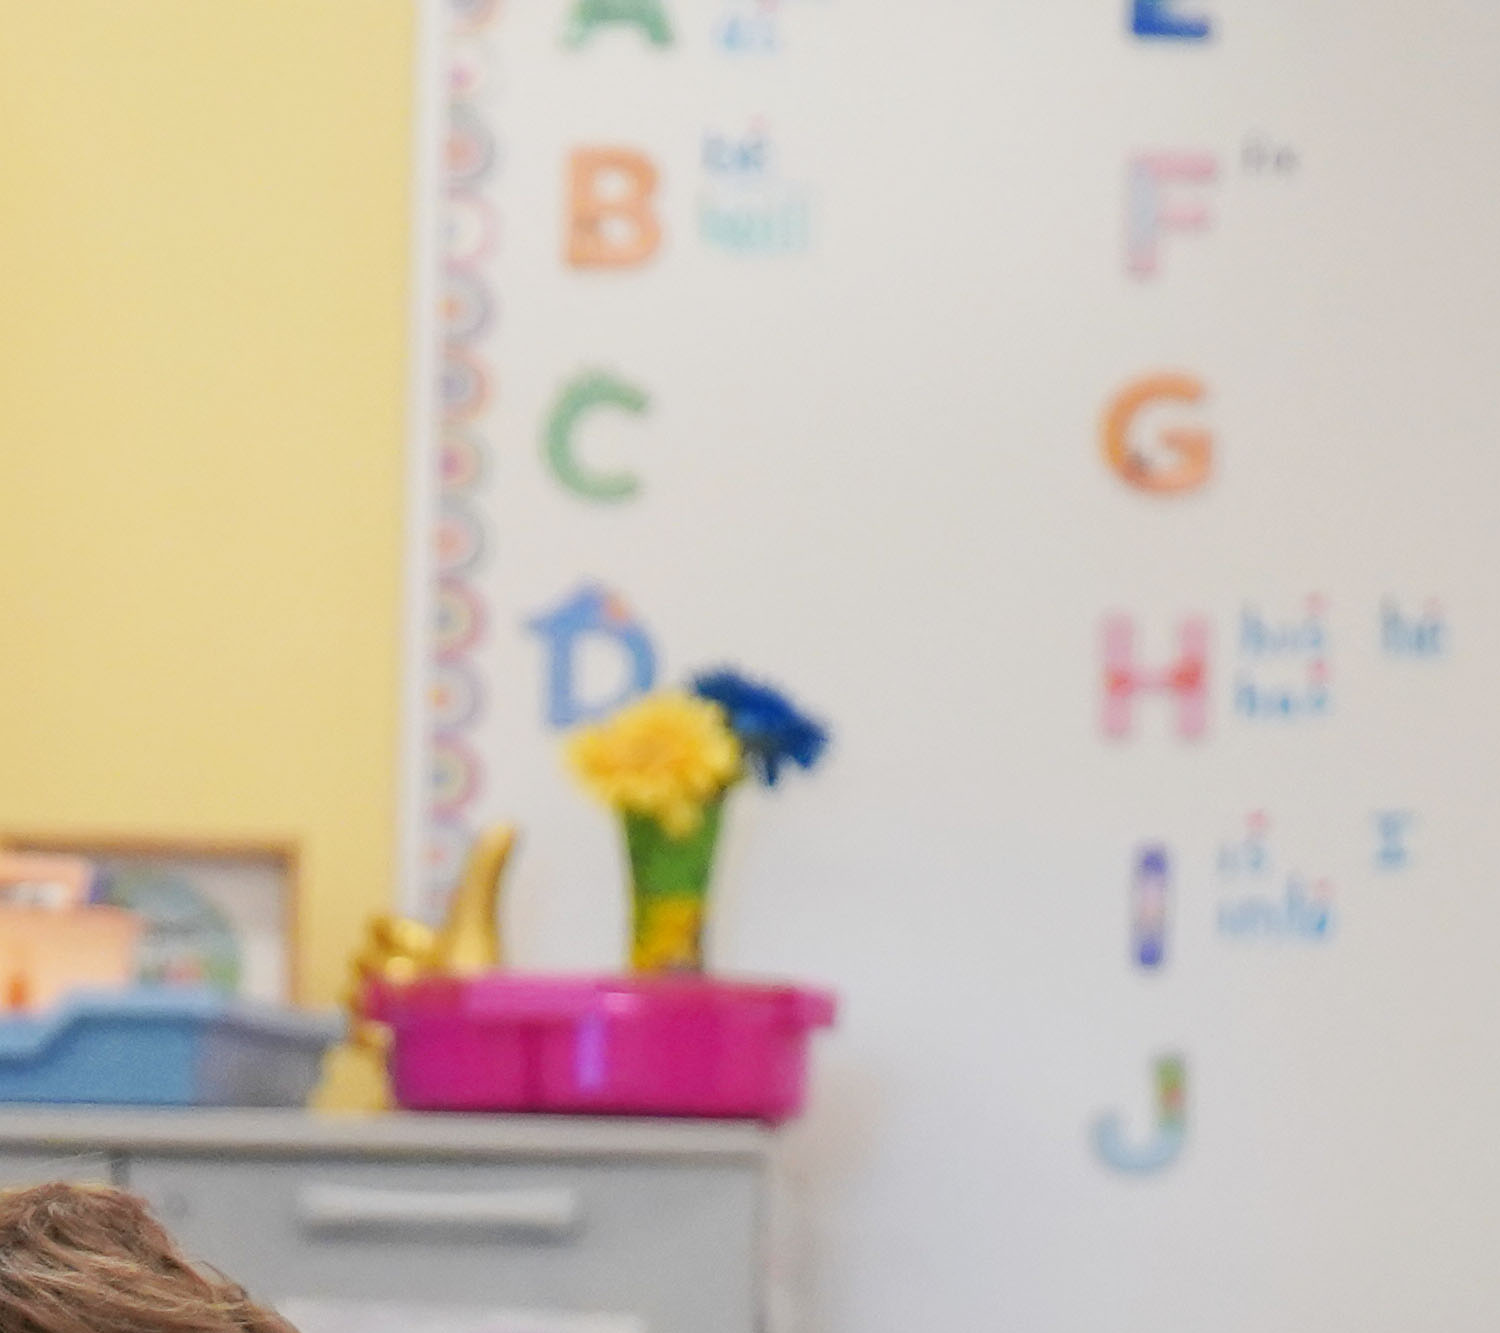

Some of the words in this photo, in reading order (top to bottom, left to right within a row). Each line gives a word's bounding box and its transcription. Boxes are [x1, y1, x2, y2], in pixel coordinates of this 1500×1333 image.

[562, 147, 662, 273] B
[1124, 151, 1222, 282] F
[539, 370, 651, 506] C
[1100, 374, 1214, 498] G
[524, 583, 660, 732] D
[1103, 618, 1211, 742] H
[1092, 1052, 1190, 1176] J
